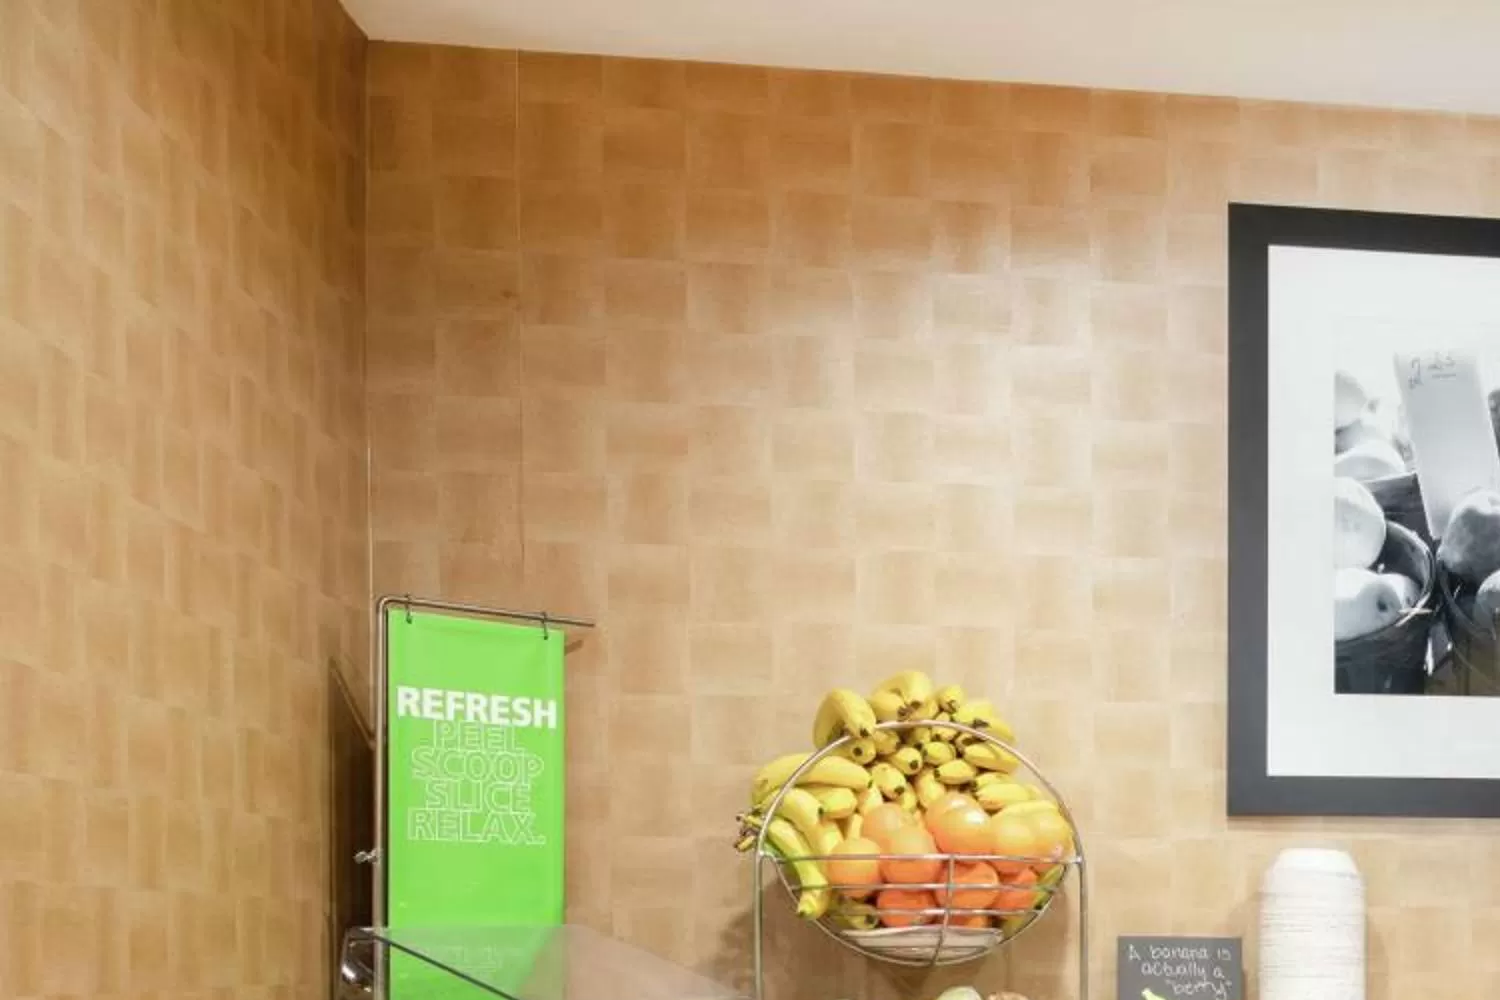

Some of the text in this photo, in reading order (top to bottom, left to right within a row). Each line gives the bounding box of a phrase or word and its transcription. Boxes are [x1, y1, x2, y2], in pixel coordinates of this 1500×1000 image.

[396, 685, 557, 729] REFRESH
[433, 719, 523, 751] PEEL
[411, 747, 544, 784] SCOOP
[425, 779, 531, 814] SLICE
[407, 807, 546, 844] RELAX.
[1150, 945, 1208, 961] banana
[1141, 961, 1207, 981] actually
